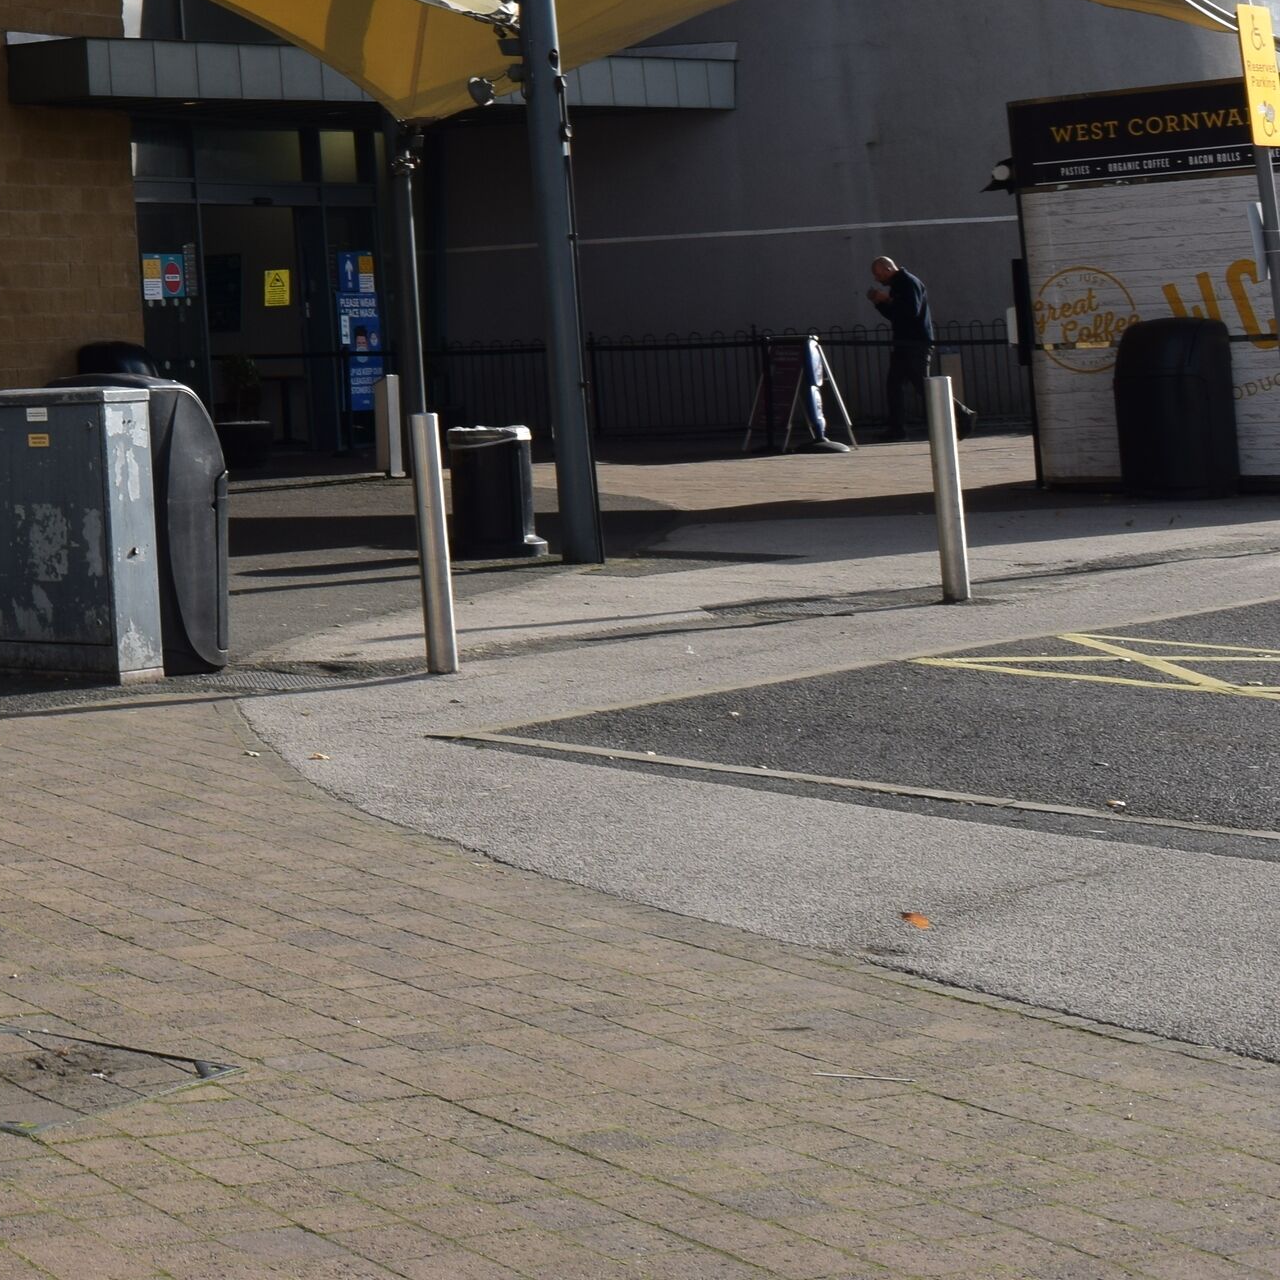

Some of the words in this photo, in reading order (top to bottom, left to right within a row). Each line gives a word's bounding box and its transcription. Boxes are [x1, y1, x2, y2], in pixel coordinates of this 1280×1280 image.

[1247, 60, 1277, 72] Reserved
[1251, 76, 1276, 90] Parking
[1050, 120, 1119, 144] WEST
[1060, 164, 1091, 177] PASTIES
[1107, 161, 1140, 173] ORGANIC
[1142, 158, 1171, 170] COFFEE
[1188, 155, 1214, 166] BACON
[1216, 152, 1241, 163] ROLLS
[1033, 288, 1100, 334] Great
[1061, 311, 1141, 347] Coffee
